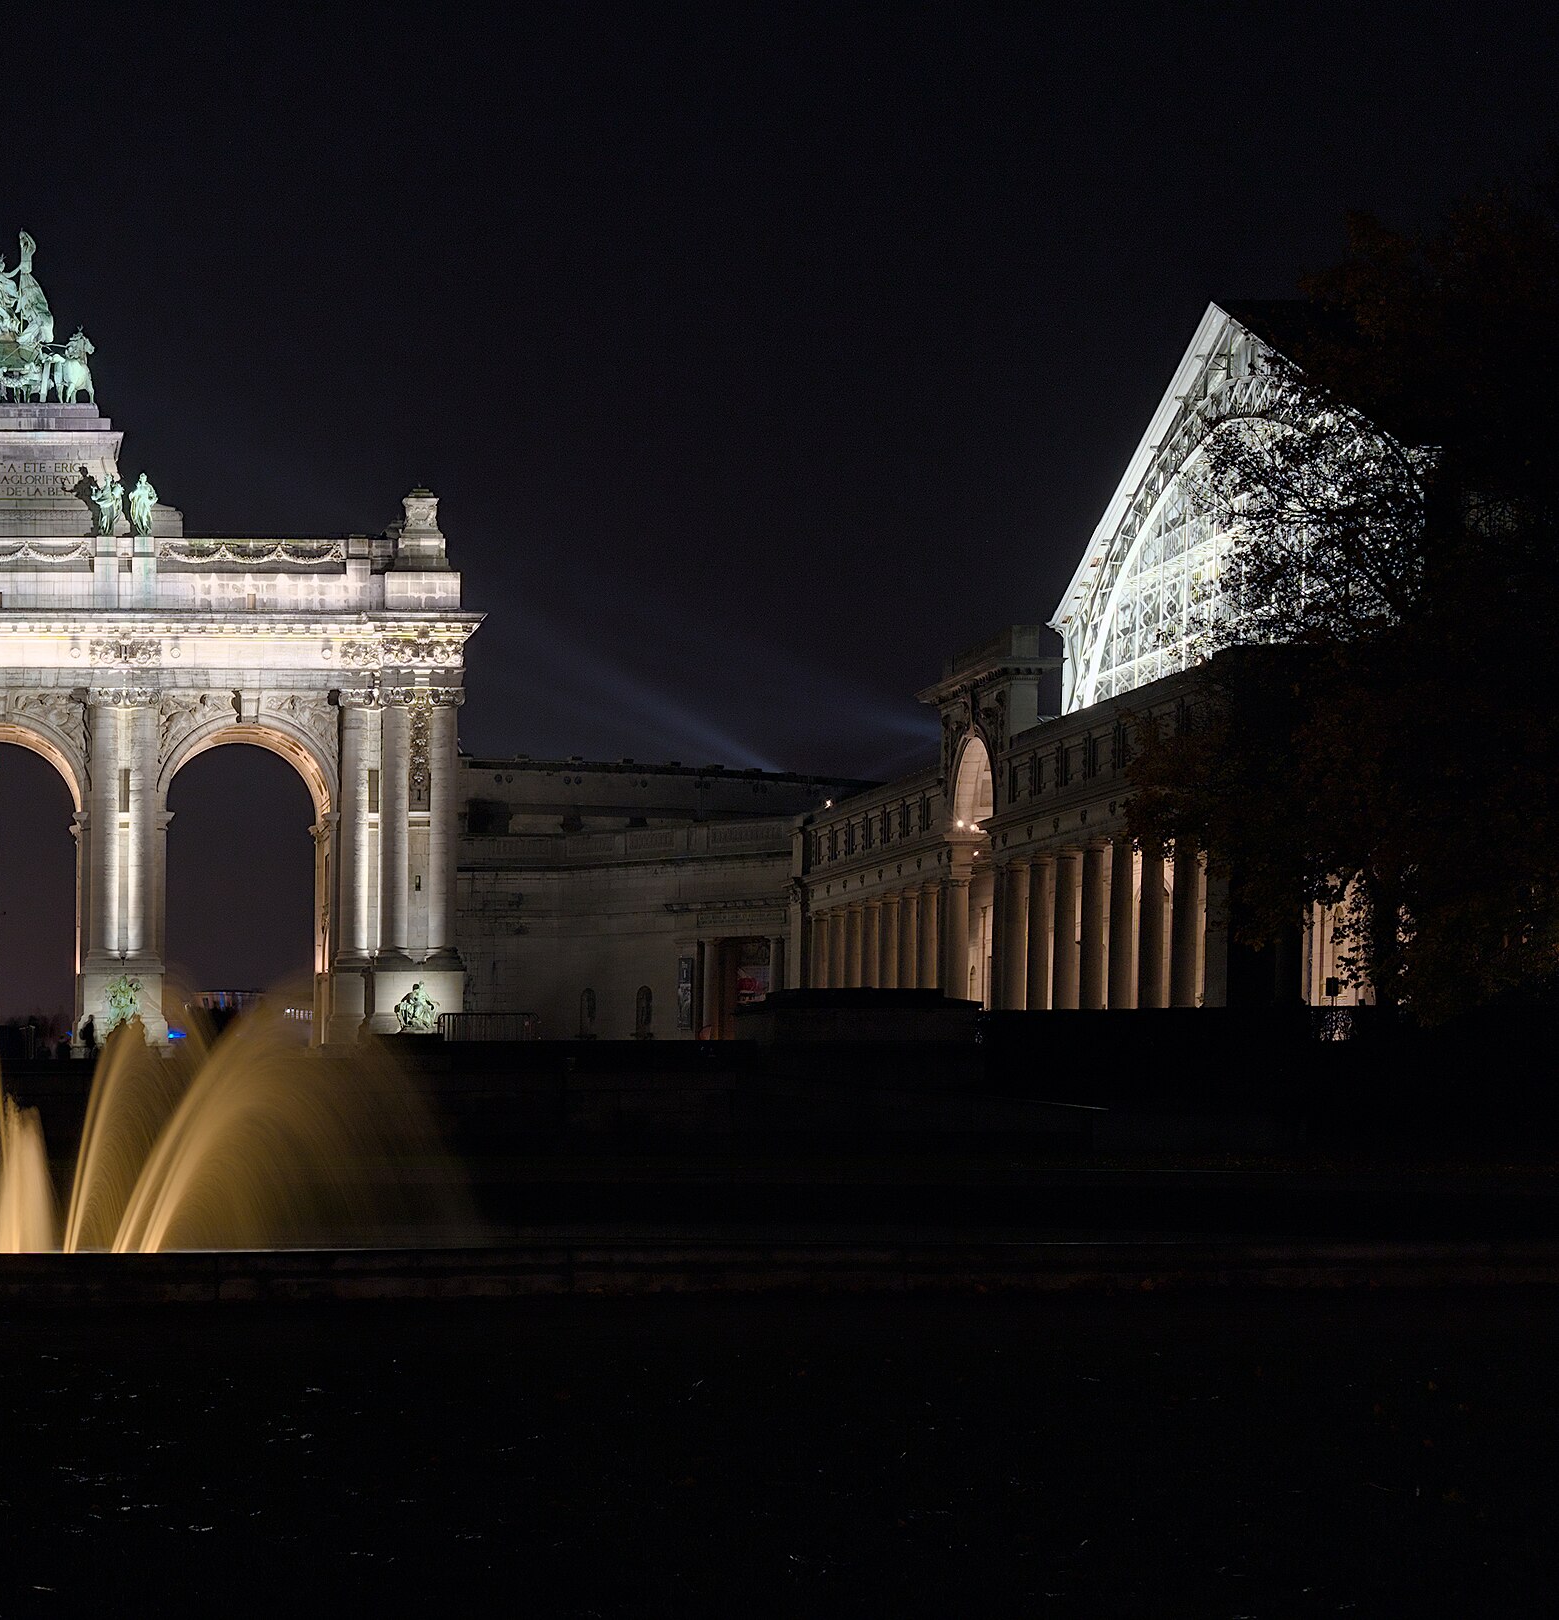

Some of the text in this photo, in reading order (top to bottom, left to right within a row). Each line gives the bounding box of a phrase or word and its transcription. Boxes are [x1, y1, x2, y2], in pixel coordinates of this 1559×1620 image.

[7, 463, 16, 473] A
[23, 462, 47, 473] ETE
[6, 487, 22, 496] DE
[27, 487, 42, 496] LA
